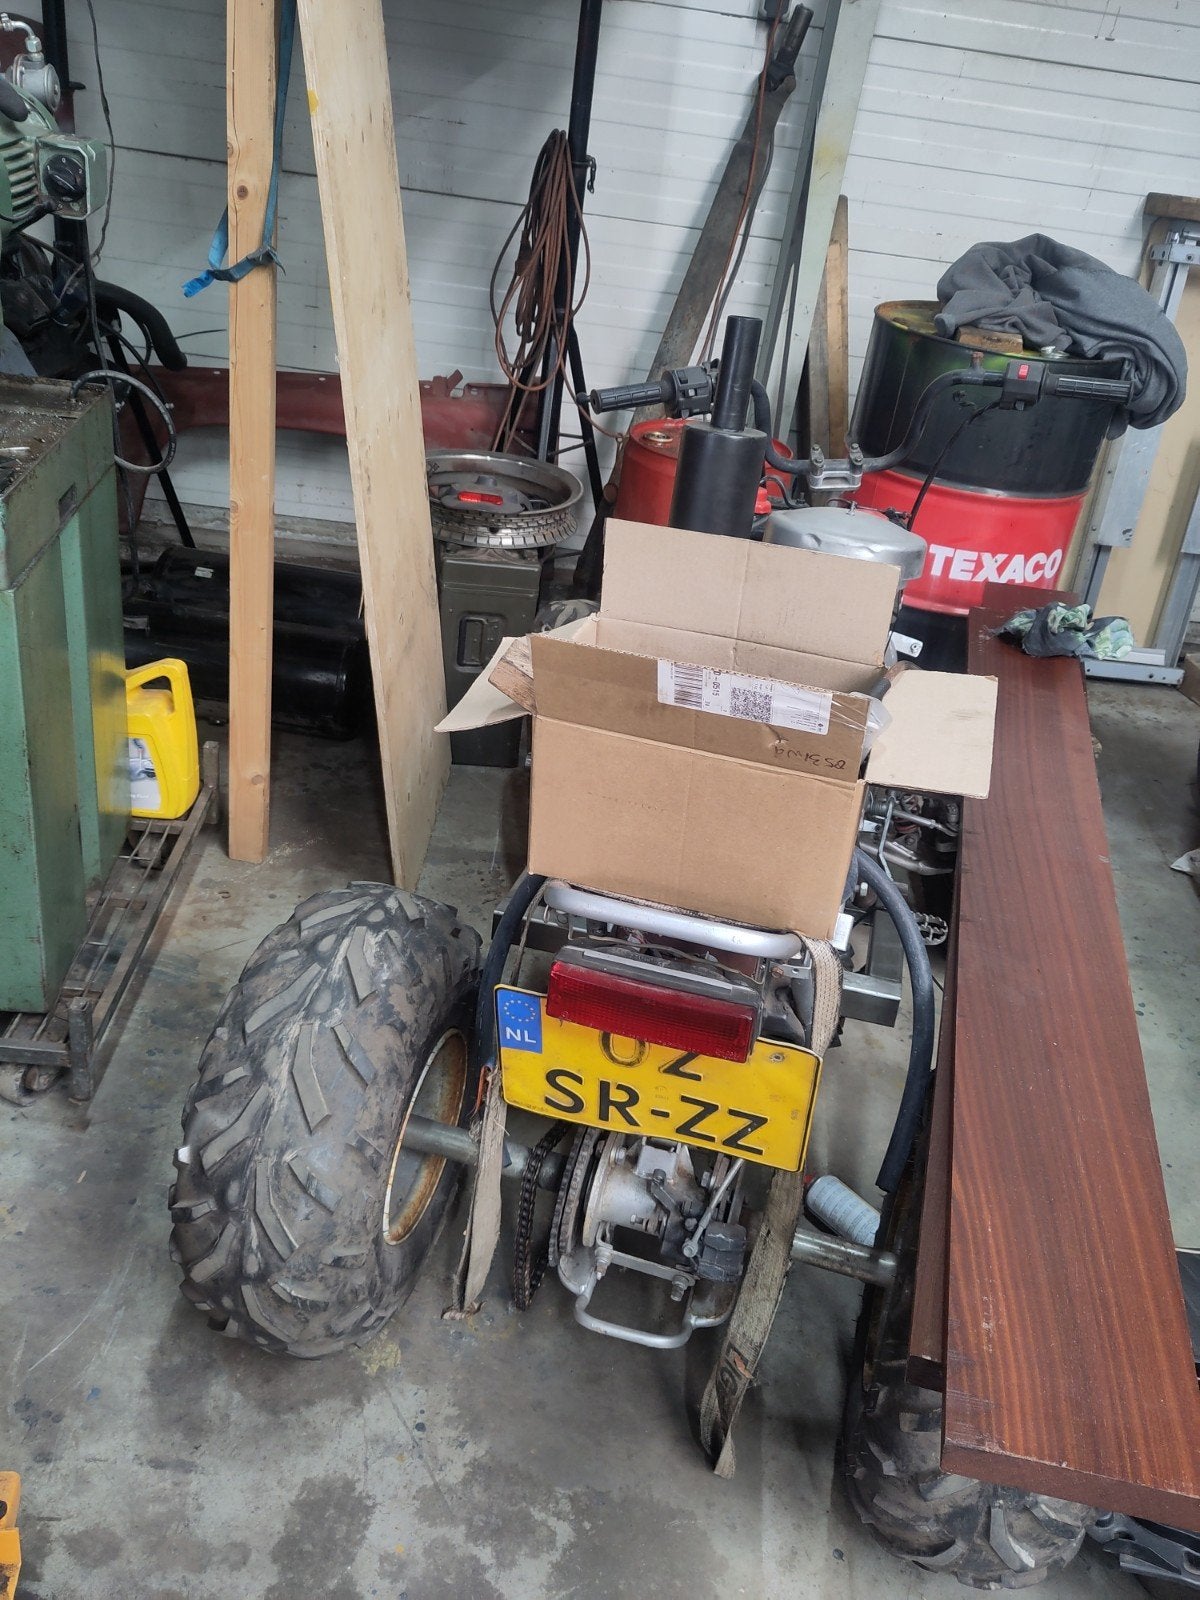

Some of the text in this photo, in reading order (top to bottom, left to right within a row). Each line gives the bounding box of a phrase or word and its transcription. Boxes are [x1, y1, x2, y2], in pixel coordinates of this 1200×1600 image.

[929, 543, 1063, 584] TEXACO
[505, 1026, 537, 1044] NL
[544, 1068, 769, 1156] SR-ZZ
